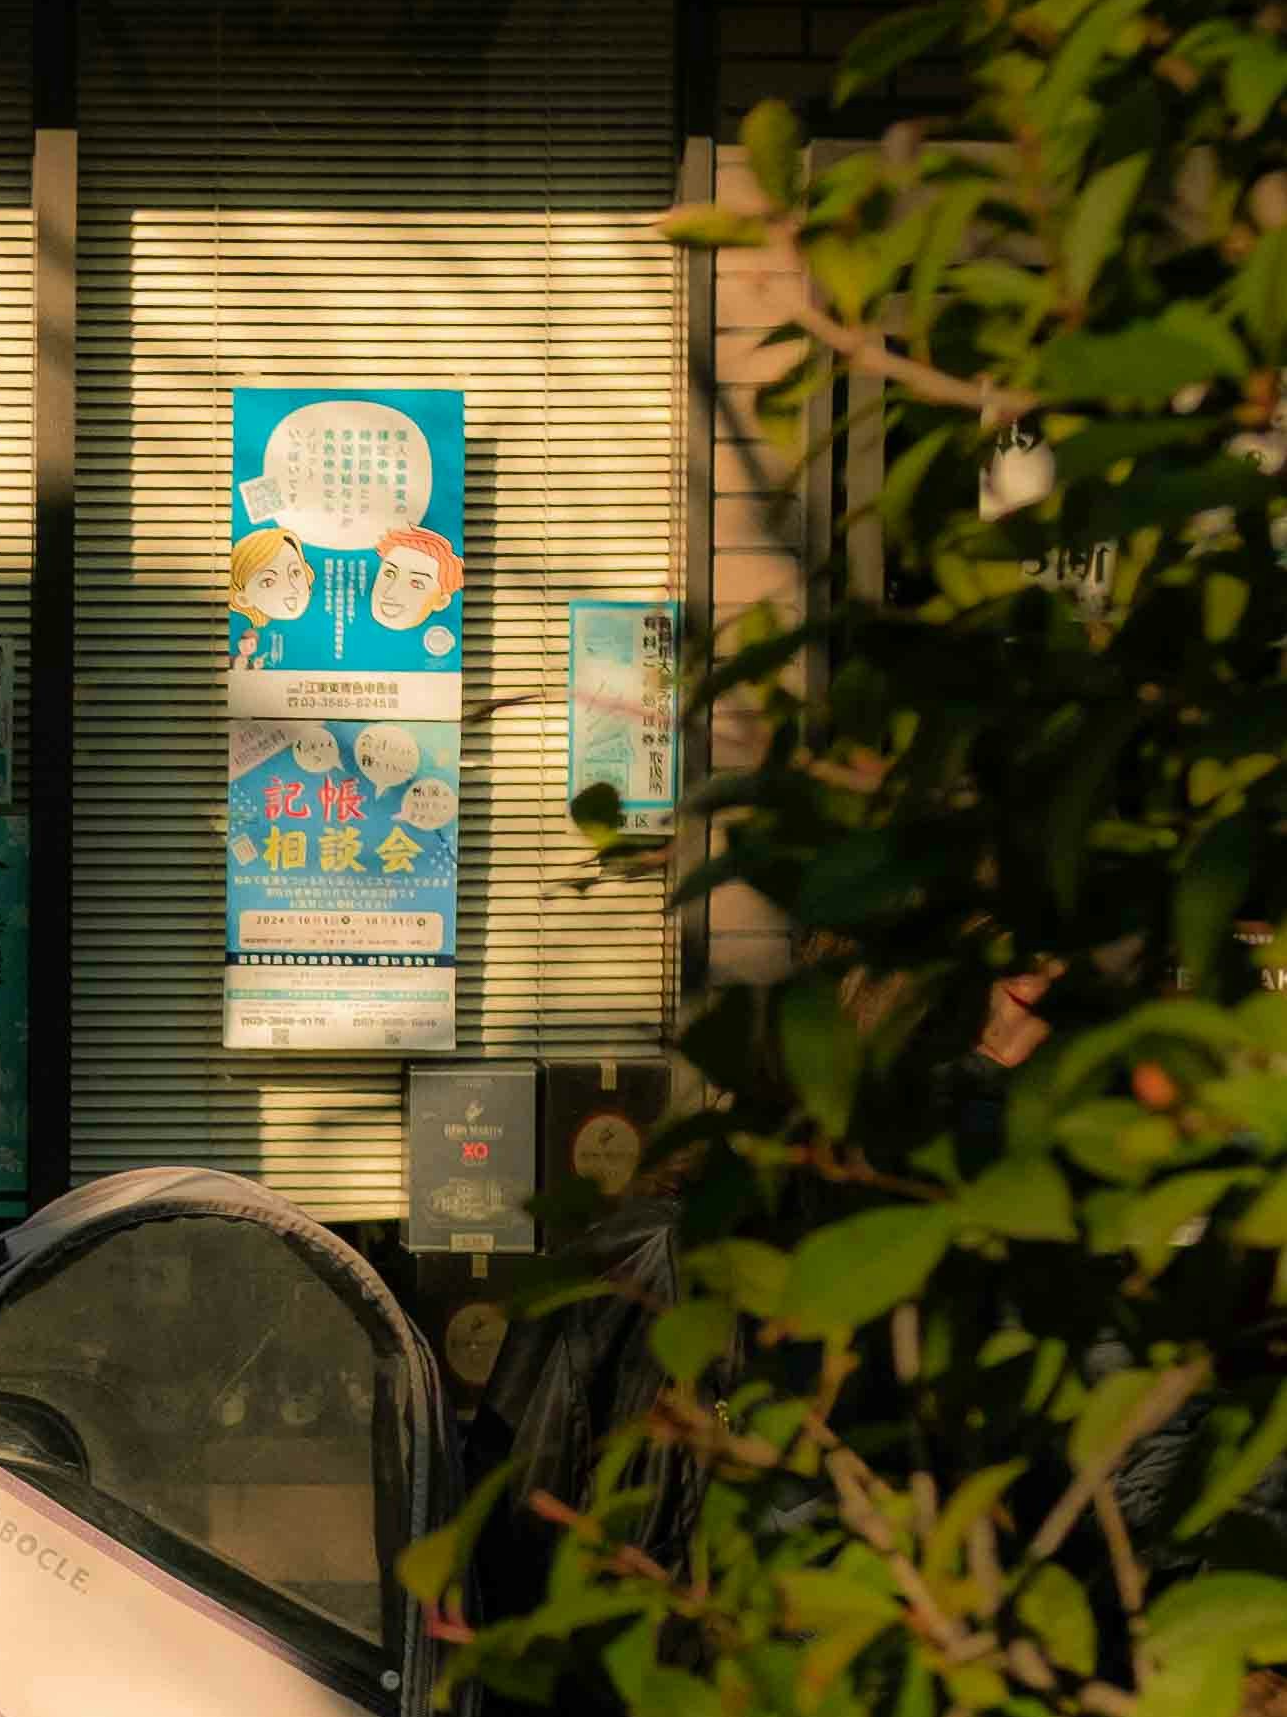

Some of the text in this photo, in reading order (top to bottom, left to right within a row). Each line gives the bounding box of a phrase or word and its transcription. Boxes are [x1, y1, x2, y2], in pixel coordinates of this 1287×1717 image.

[263, 777, 367, 822] 記帳
[263, 826, 425, 872] 相談会
[461, 1141, 489, 1160] XO
